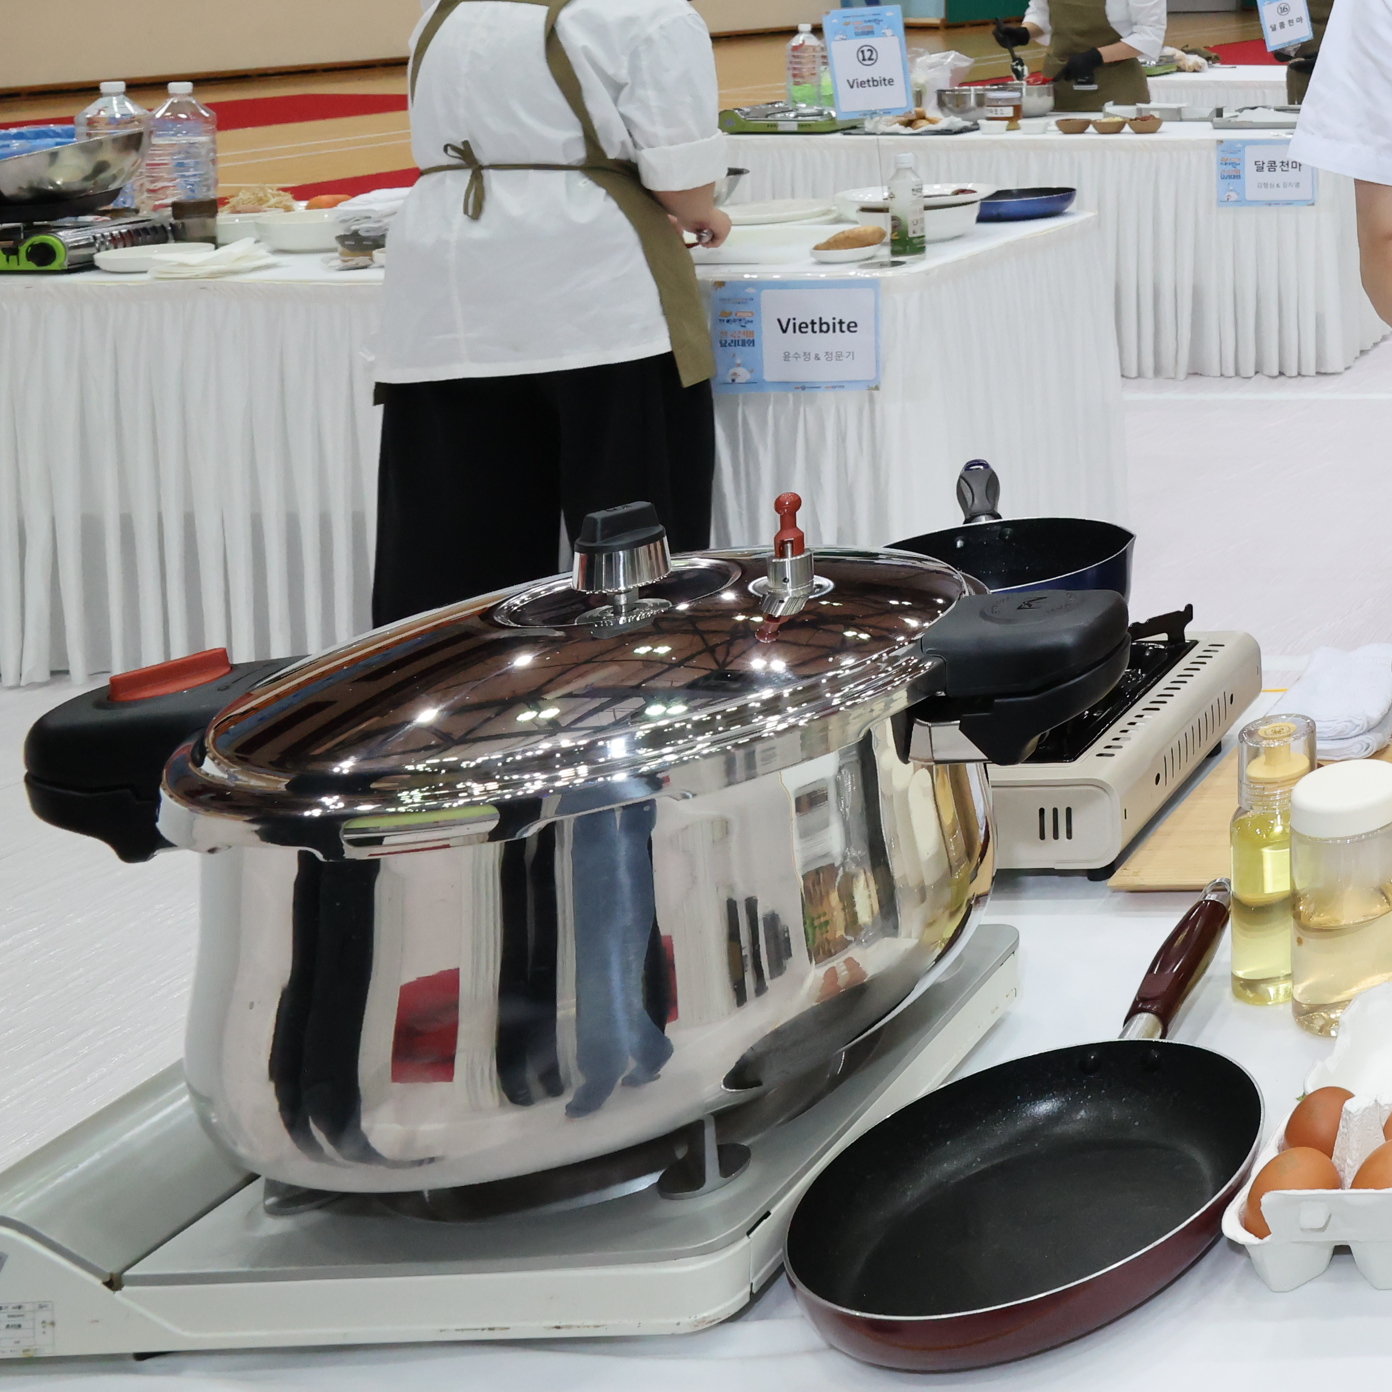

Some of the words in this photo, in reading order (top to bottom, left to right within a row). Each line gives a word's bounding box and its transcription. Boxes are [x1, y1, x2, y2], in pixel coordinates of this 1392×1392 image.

[846, 76, 895, 89] Vietbite
[1254, 159, 1302, 173] 달콤천마
[776, 317, 858, 334] Vietbite
[814, 353, 821, 361] &
